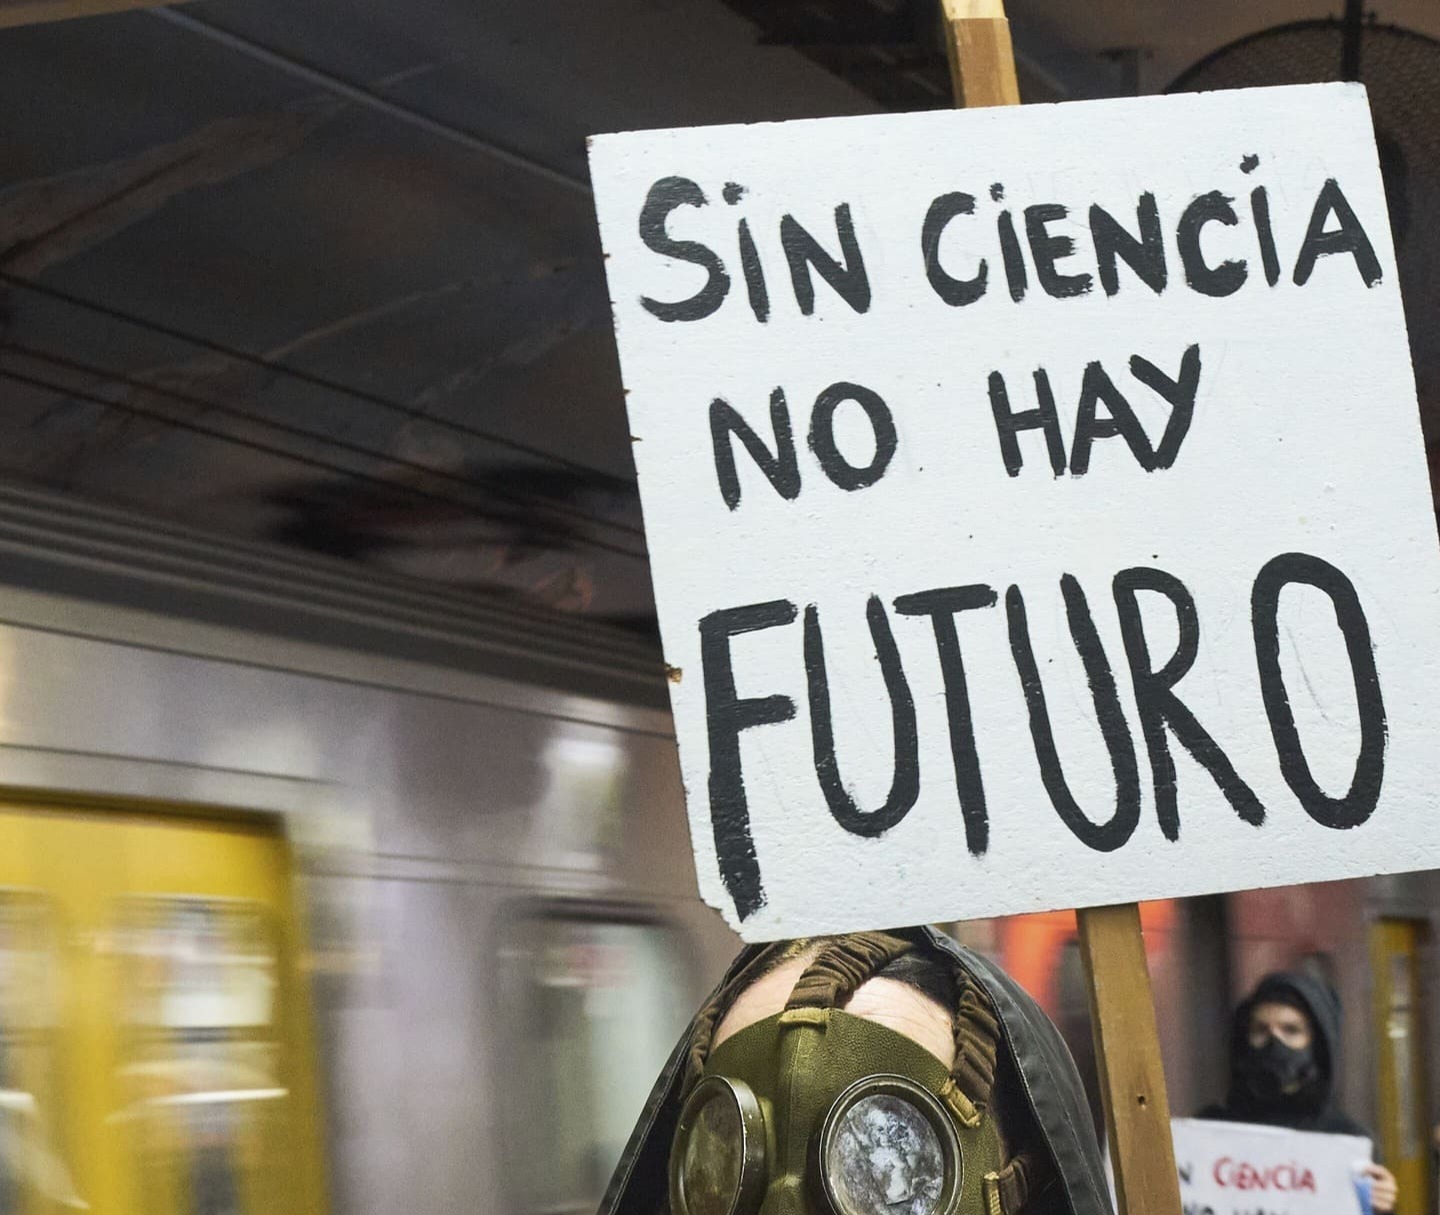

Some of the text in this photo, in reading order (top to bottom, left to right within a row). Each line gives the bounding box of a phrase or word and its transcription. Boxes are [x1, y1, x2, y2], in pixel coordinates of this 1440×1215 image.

[710, 344, 1202, 511] NO HAY
[698, 553, 1388, 922] FUTURO
